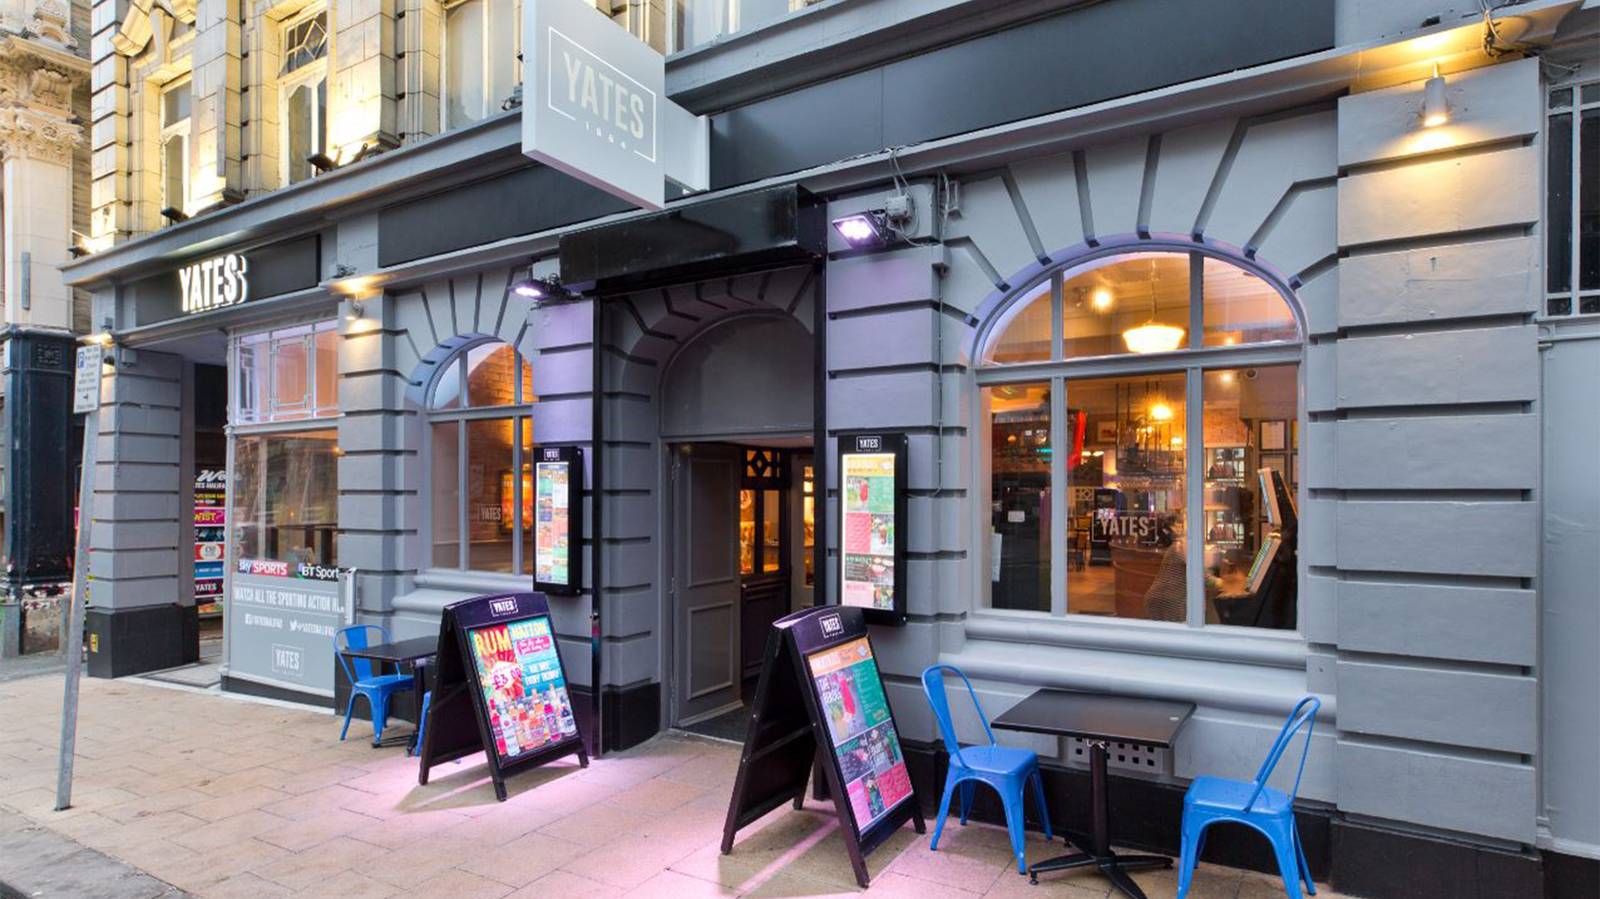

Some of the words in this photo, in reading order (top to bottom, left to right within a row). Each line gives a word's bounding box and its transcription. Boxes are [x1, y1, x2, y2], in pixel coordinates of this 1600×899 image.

[563, 51, 645, 140] YATES
[179, 253, 244, 313] YATES
[859, 438, 879, 449] YATES
[481, 507, 501, 521] YATES
[1099, 516, 1149, 537] YATES
[252, 561, 288, 576] SPORTS
[302, 565, 314, 577] BT
[315, 565, 339, 580] Sport
[235, 586, 253, 601] WATCH
[254, 588, 265, 604] ALL
[266, 590, 277, 605] THE
[278, 591, 307, 609] SPORTING
[308, 594, 331, 611] ACTION
[493, 600, 515, 613] YATES
[474, 627, 512, 657] RUM
[275, 649, 300, 671] YATES
